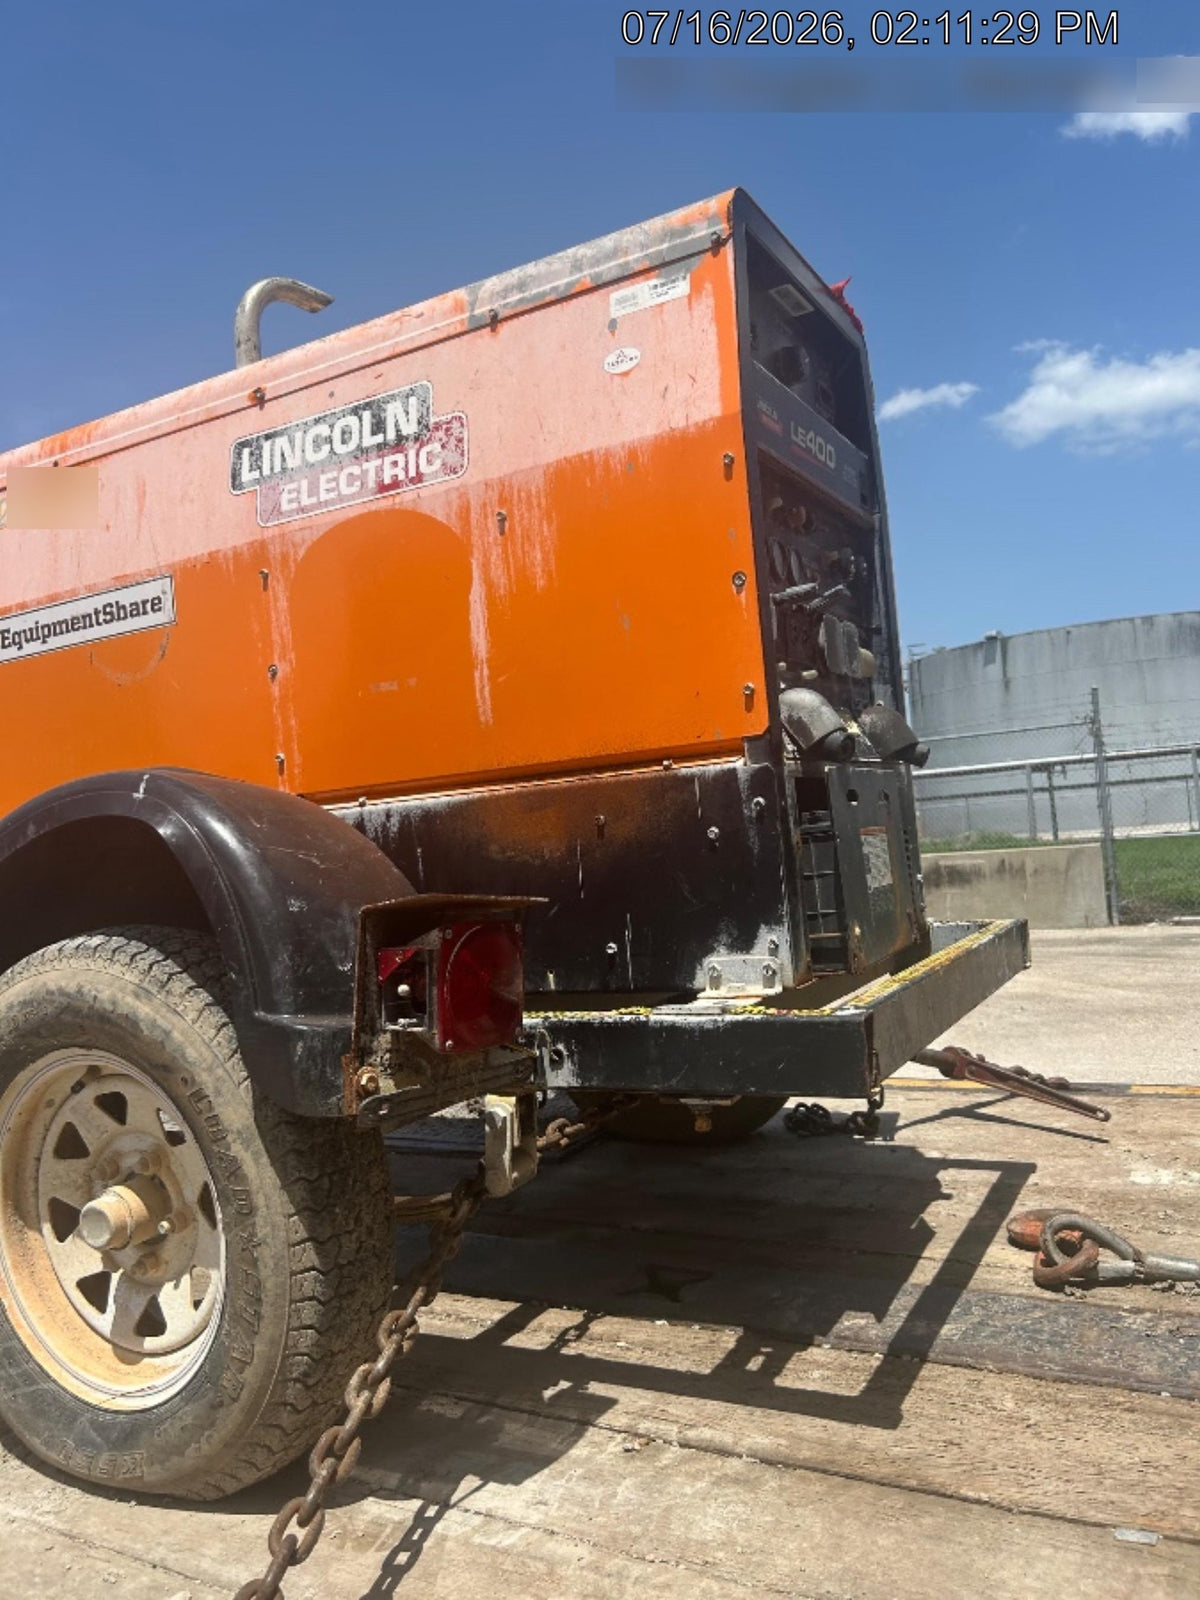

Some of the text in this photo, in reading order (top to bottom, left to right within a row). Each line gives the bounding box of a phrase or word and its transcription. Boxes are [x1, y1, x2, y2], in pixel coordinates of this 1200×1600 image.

[240, 395, 419, 483] LINCOLN
[789, 420, 837, 470] LE400
[279, 442, 442, 512] ELECTRIC
[0, 594, 163, 652] EquipmentShare
